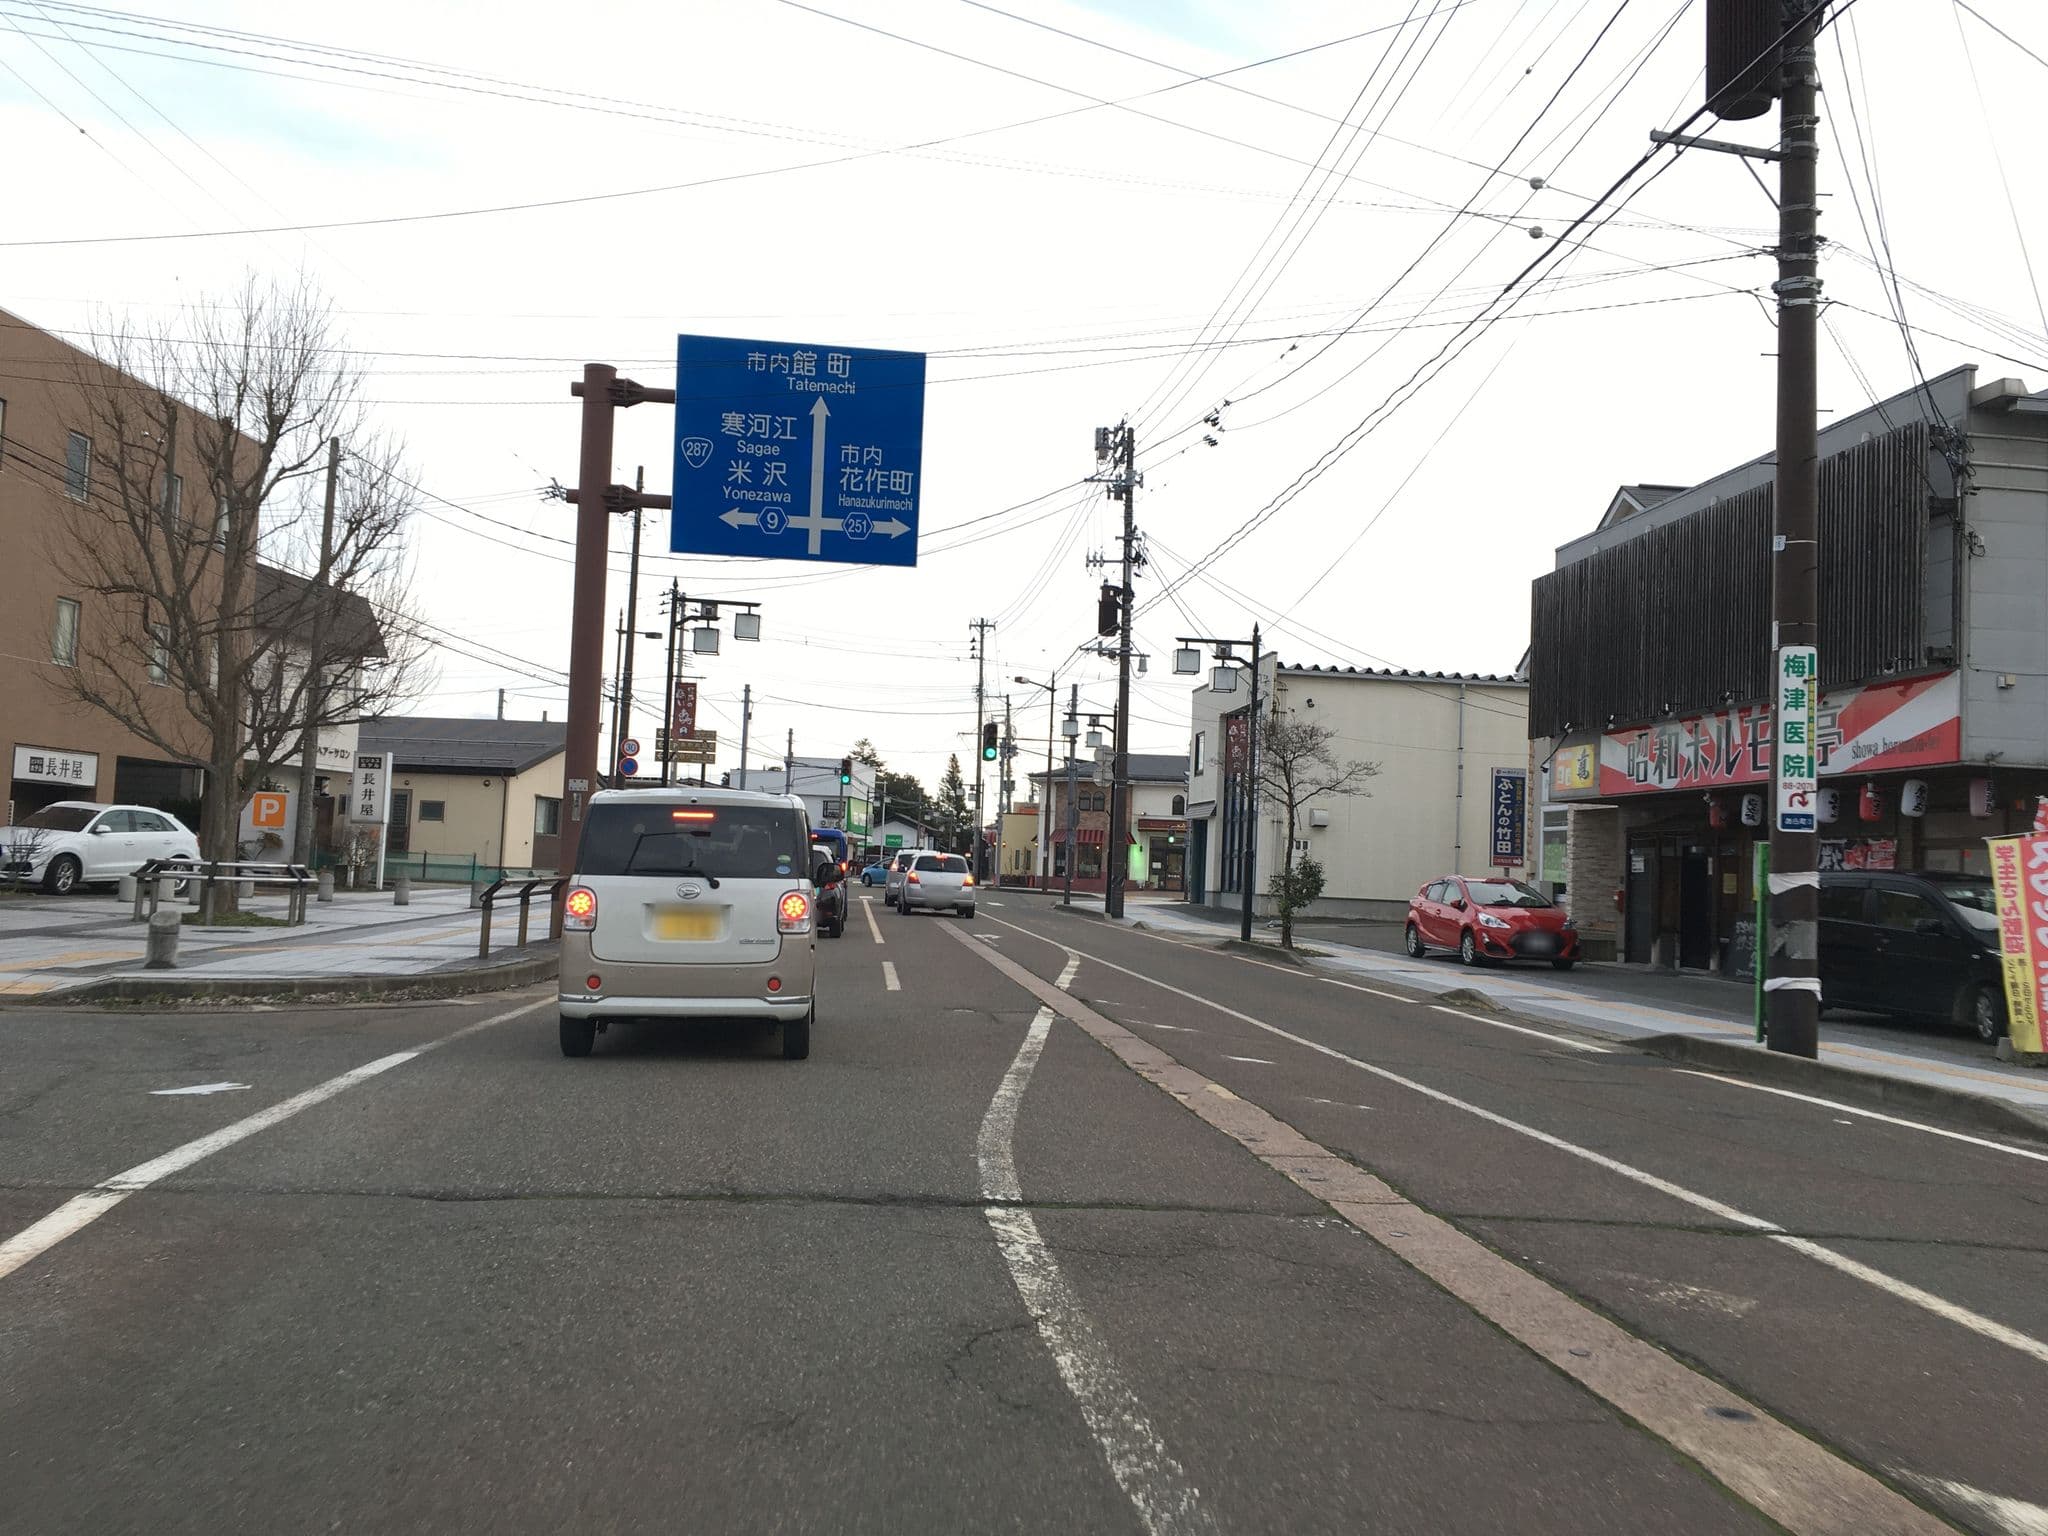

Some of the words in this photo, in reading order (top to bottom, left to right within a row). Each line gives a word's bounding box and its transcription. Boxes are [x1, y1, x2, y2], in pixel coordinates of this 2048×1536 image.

[787, 377, 855, 394] Tatemachi
[721, 411, 798, 440] 寒河江
[685, 442, 708, 457] 287
[737, 440, 780, 456] Sagae
[840, 444, 882, 466] 市内
[727, 459, 787, 486] 米沢
[839, 467, 914, 495] 花作町
[723, 486, 791, 503] Yonezawa
[838, 494, 913, 511] Hanazukurimachi
[766, 514, 778, 529] 9
[848, 519, 867, 533] 251
[1783, 653, 1807, 778] 梅津医院
[625, 743, 636, 752] 30
[45, 757, 83, 779] 長井屋
[360, 773, 376, 816] 長井屋
[259, 799, 280, 822] P
[1496, 778, 1514, 853] ふとんの竹田
